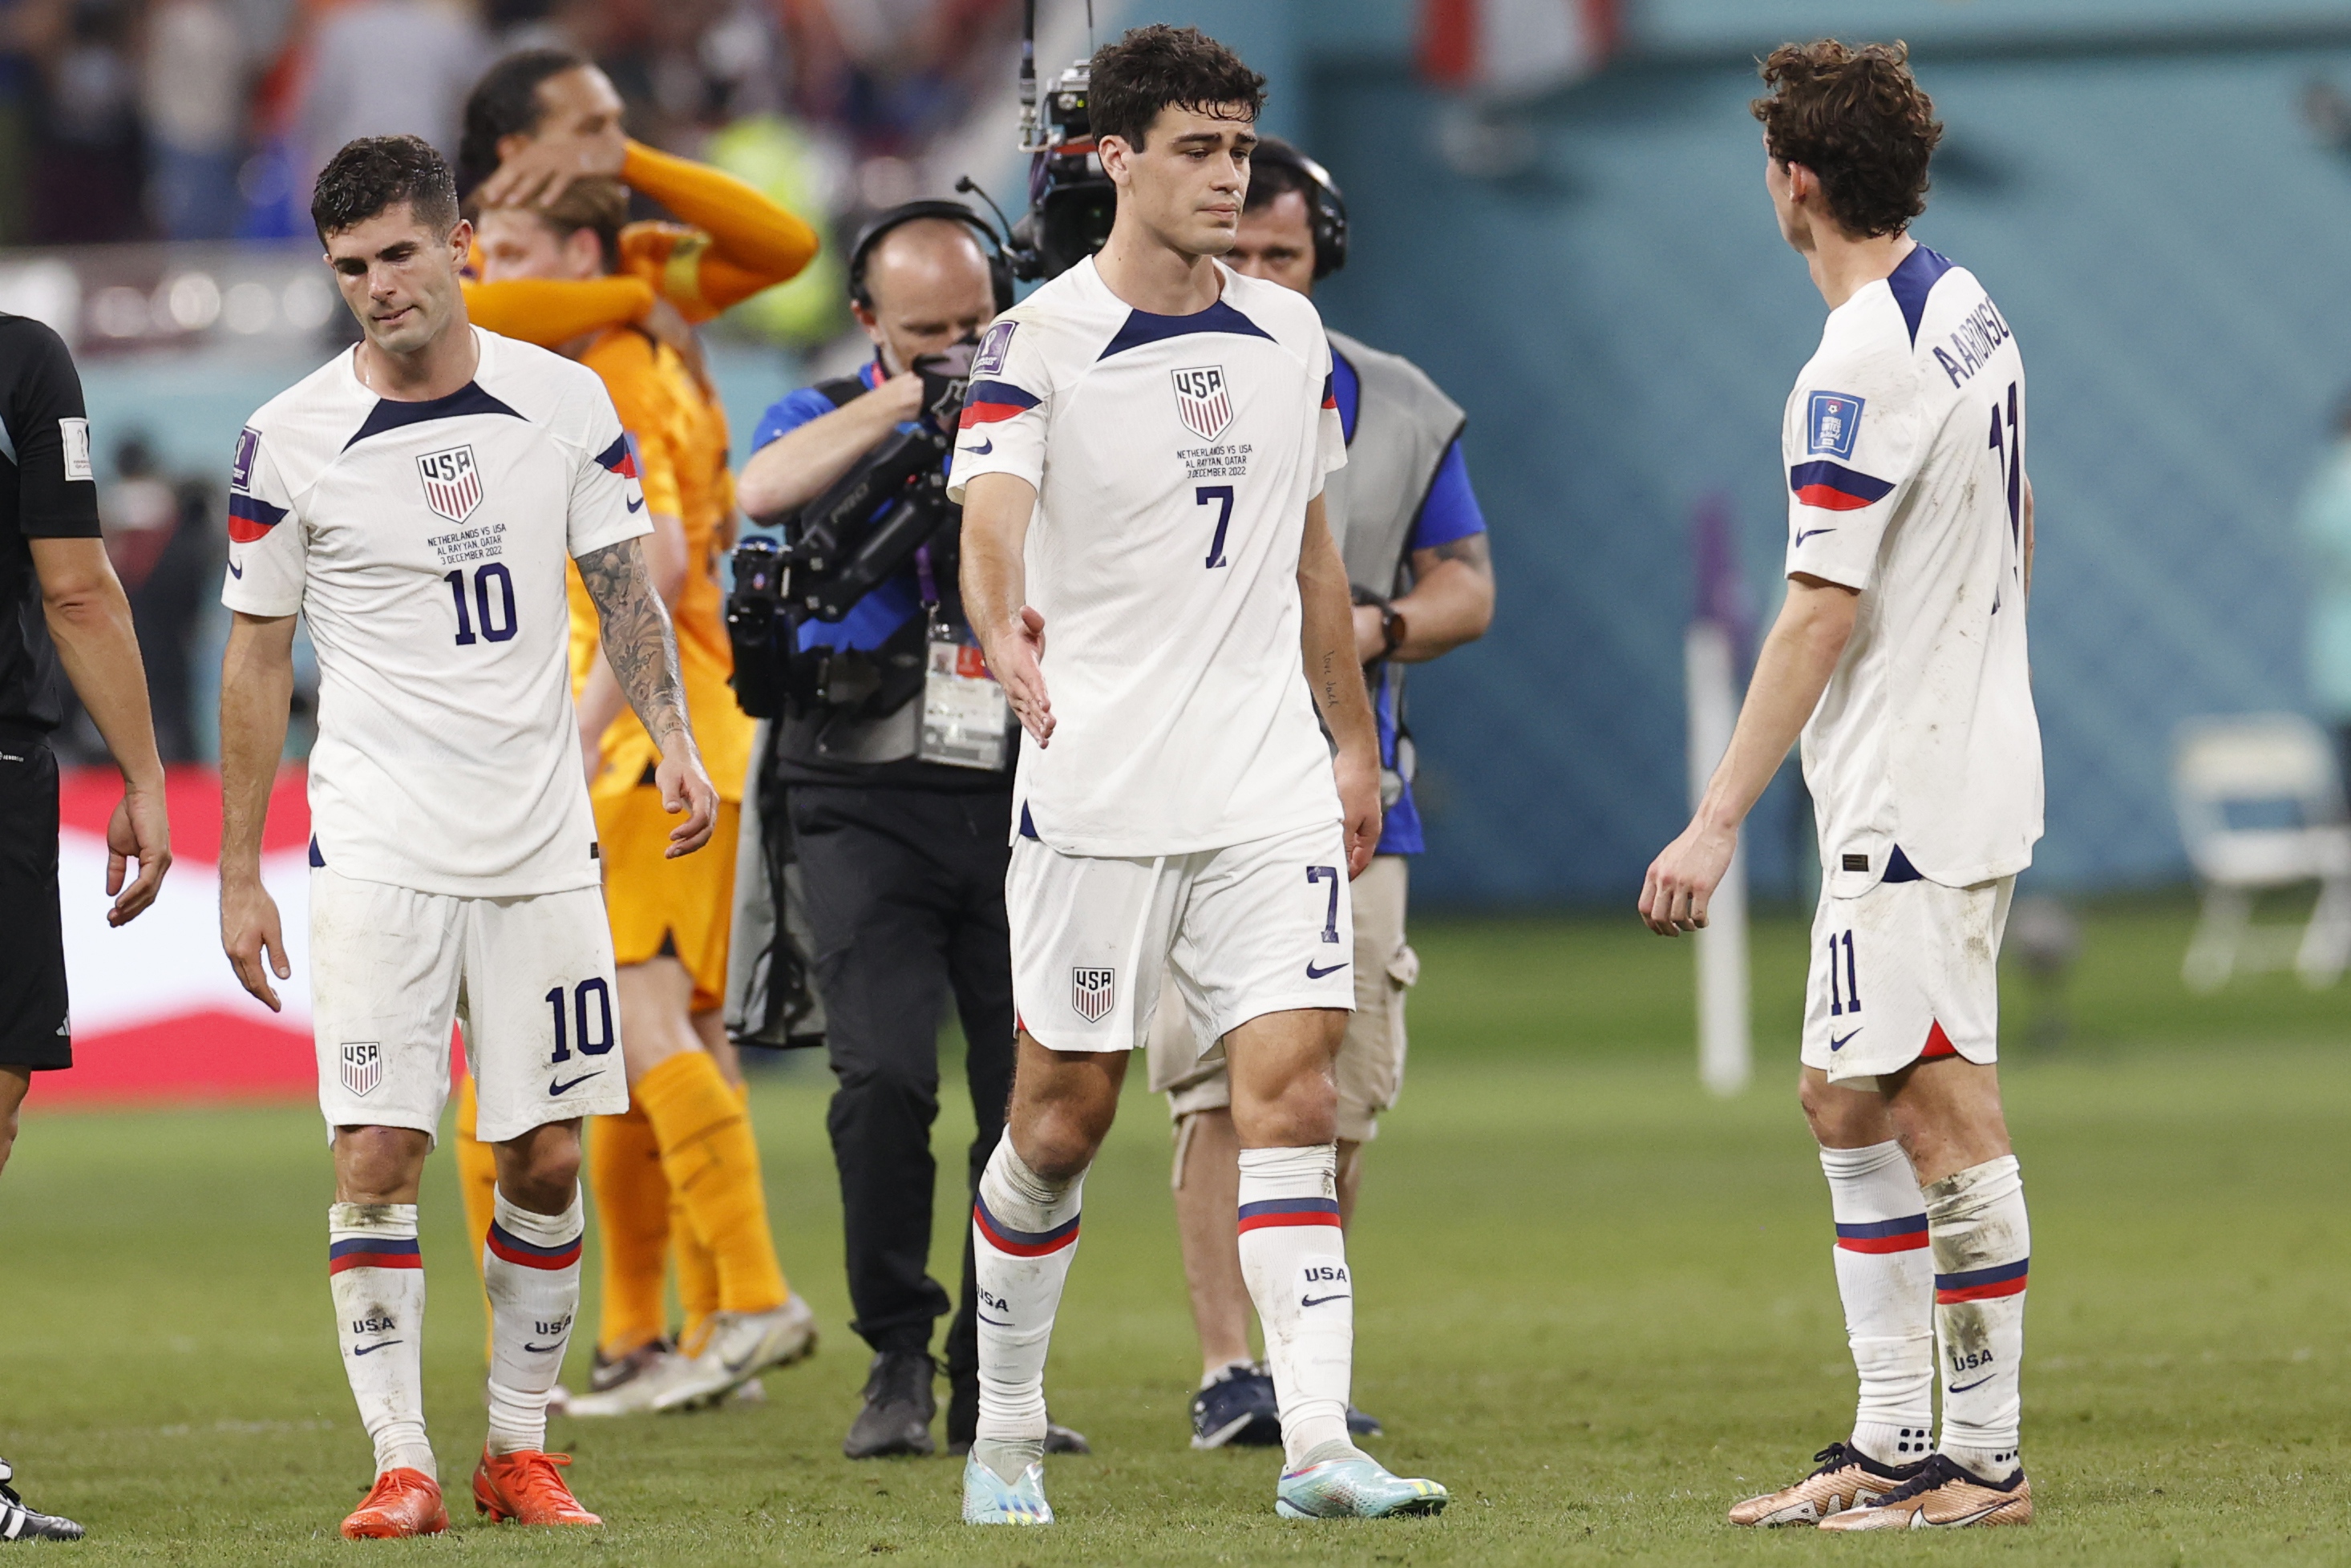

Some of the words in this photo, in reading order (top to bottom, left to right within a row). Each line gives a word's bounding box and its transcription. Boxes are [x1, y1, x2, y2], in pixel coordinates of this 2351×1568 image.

[1176, 370, 1222, 399] USA
[1177, 446, 1225, 459] NETHERLANDS
[1227, 446, 1236, 454] VS
[1239, 444, 1252, 454] USA
[1186, 460, 1195, 468] AL
[1225, 455, 1247, 465] QATAR
[422, 451, 471, 481] USA
[1187, 470, 1192, 479] 3
[1192, 467, 1227, 478] DECEMBER
[1228, 467, 1246, 476] 2022
[427, 528, 480, 547] NETHERLANDS
[480, 526, 491, 535] VS
[492, 523, 507, 534] USA
[1196, 485, 1235, 569] 7
[437, 547, 447, 556] AL
[480, 535, 502, 547] QATAR
[440, 556, 446, 565] 3
[447, 549, 484, 564] DECEMBER
[486, 546, 503, 556] 2022
[444, 562, 518, 646] 10
[1305, 866, 1339, 944] 7
[1076, 970, 1111, 990] USA
[1829, 929, 1862, 1016] 11
[545, 976, 614, 1063] 10
[344, 1044, 378, 1066] USA
[1305, 1267, 1347, 1283] USA
[977, 1283, 1009, 1313] USA
[353, 1317, 396, 1334] USA
[536, 1315, 571, 1336] USA
[1953, 1349, 1993, 1372] USA
